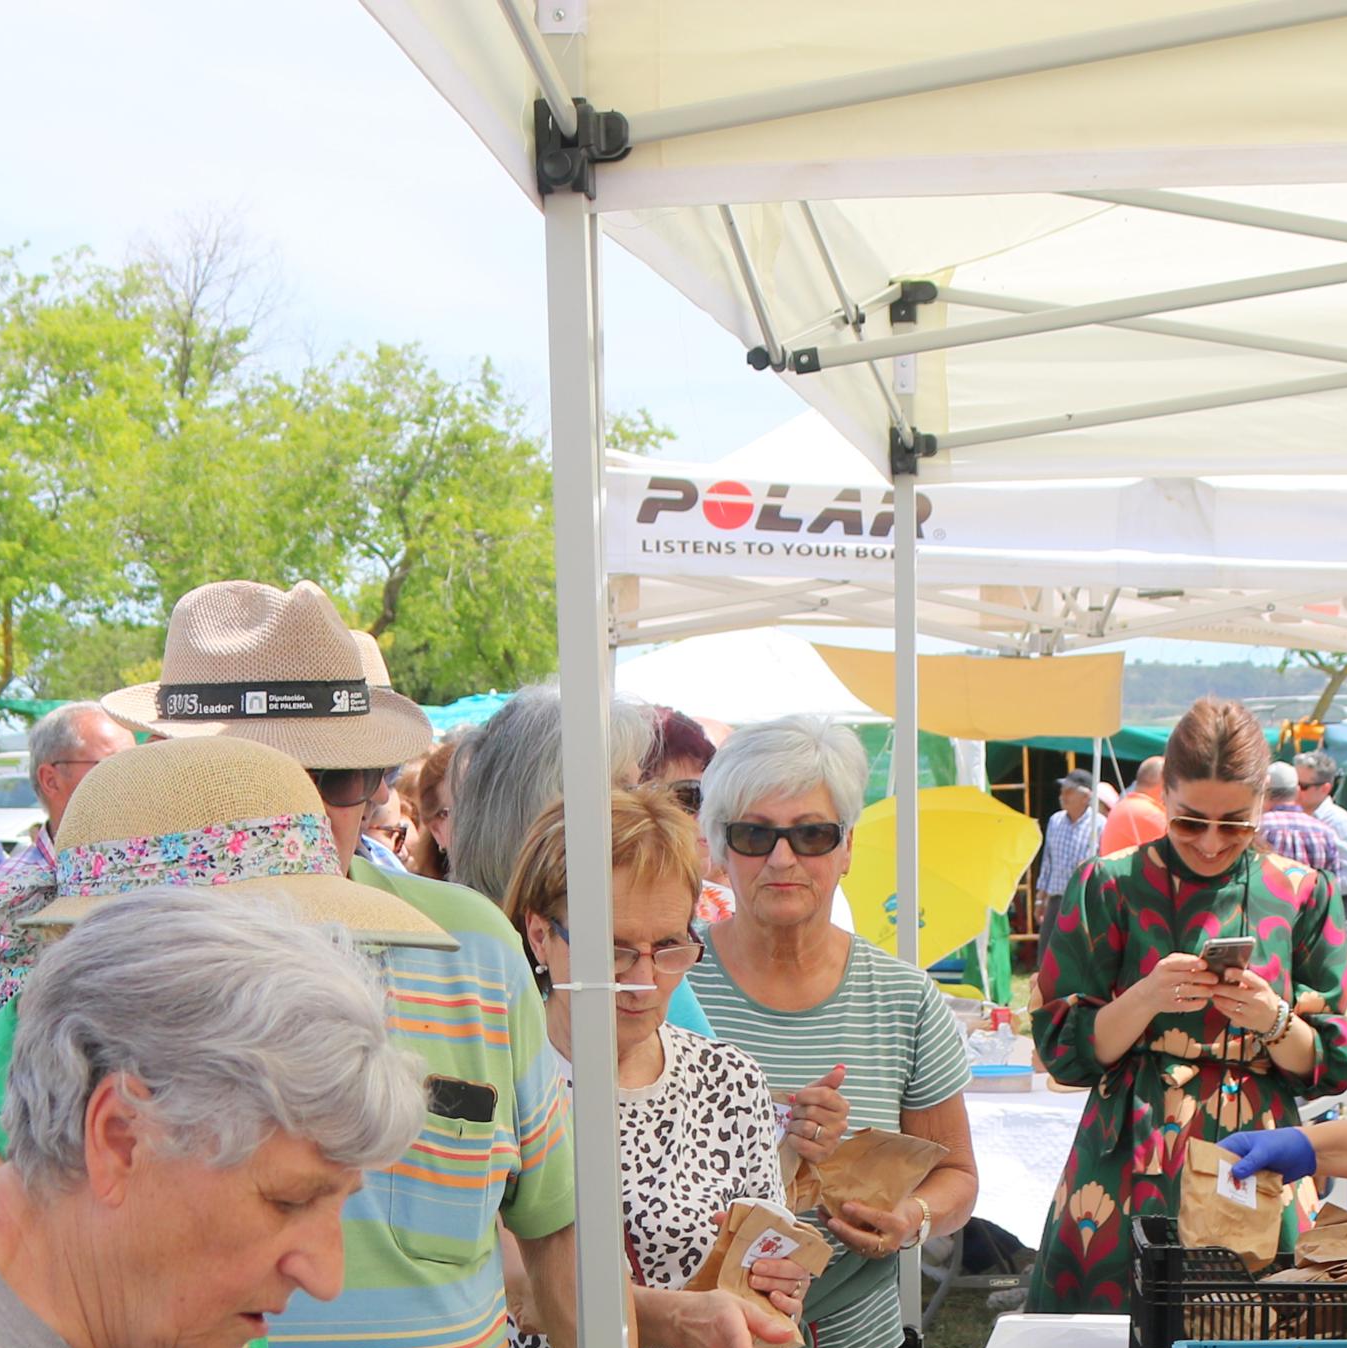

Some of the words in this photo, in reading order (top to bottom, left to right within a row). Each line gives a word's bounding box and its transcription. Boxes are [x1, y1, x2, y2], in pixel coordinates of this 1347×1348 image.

[636, 476, 933, 539] POLAR
[641, 539, 737, 555] LISTENS
[743, 541, 775, 556] TO
[782, 543, 847, 559] YOUR
[280, 702, 313, 710] PALENCIA
